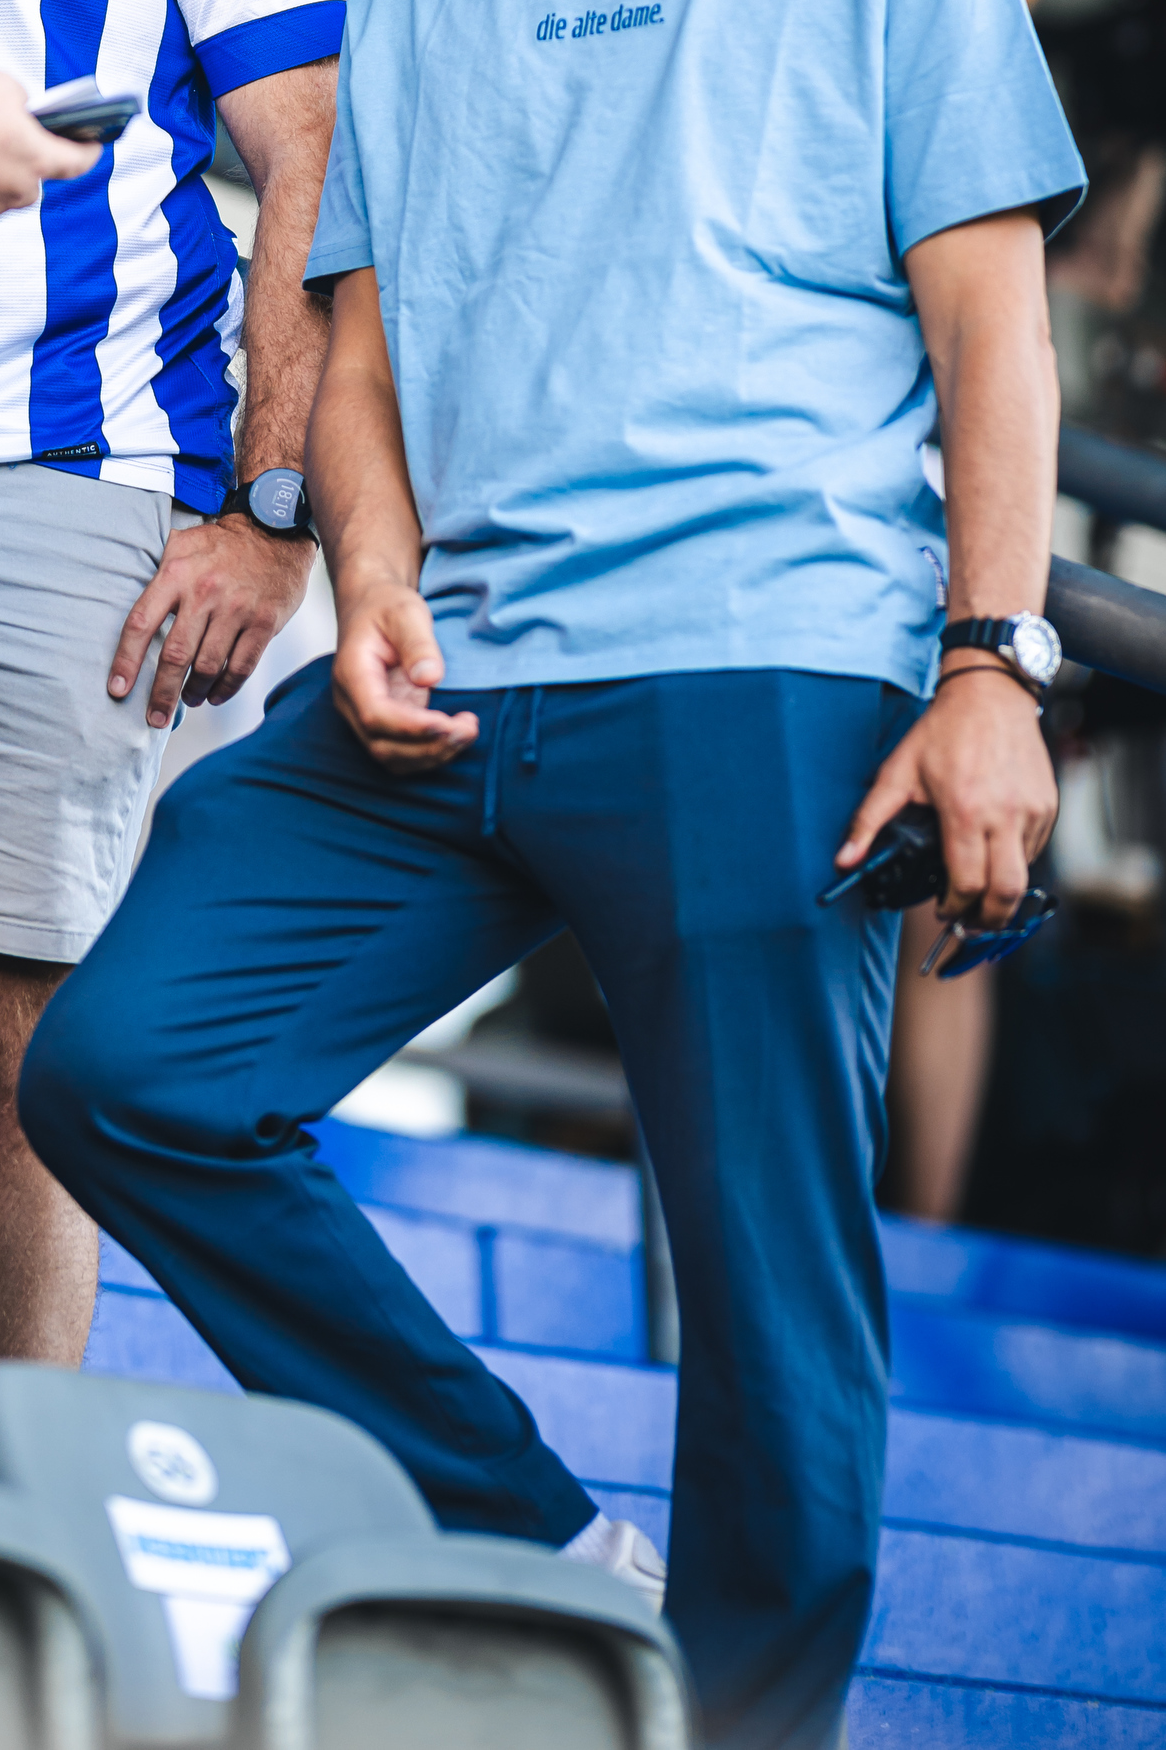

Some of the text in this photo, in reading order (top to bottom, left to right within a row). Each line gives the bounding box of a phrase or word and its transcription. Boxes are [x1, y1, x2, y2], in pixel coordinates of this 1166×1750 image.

[536, 3, 665, 41] die alte dame.
[47, 444, 96, 457] AUTHENTIC
[272, 484, 295, 518] 18:19
